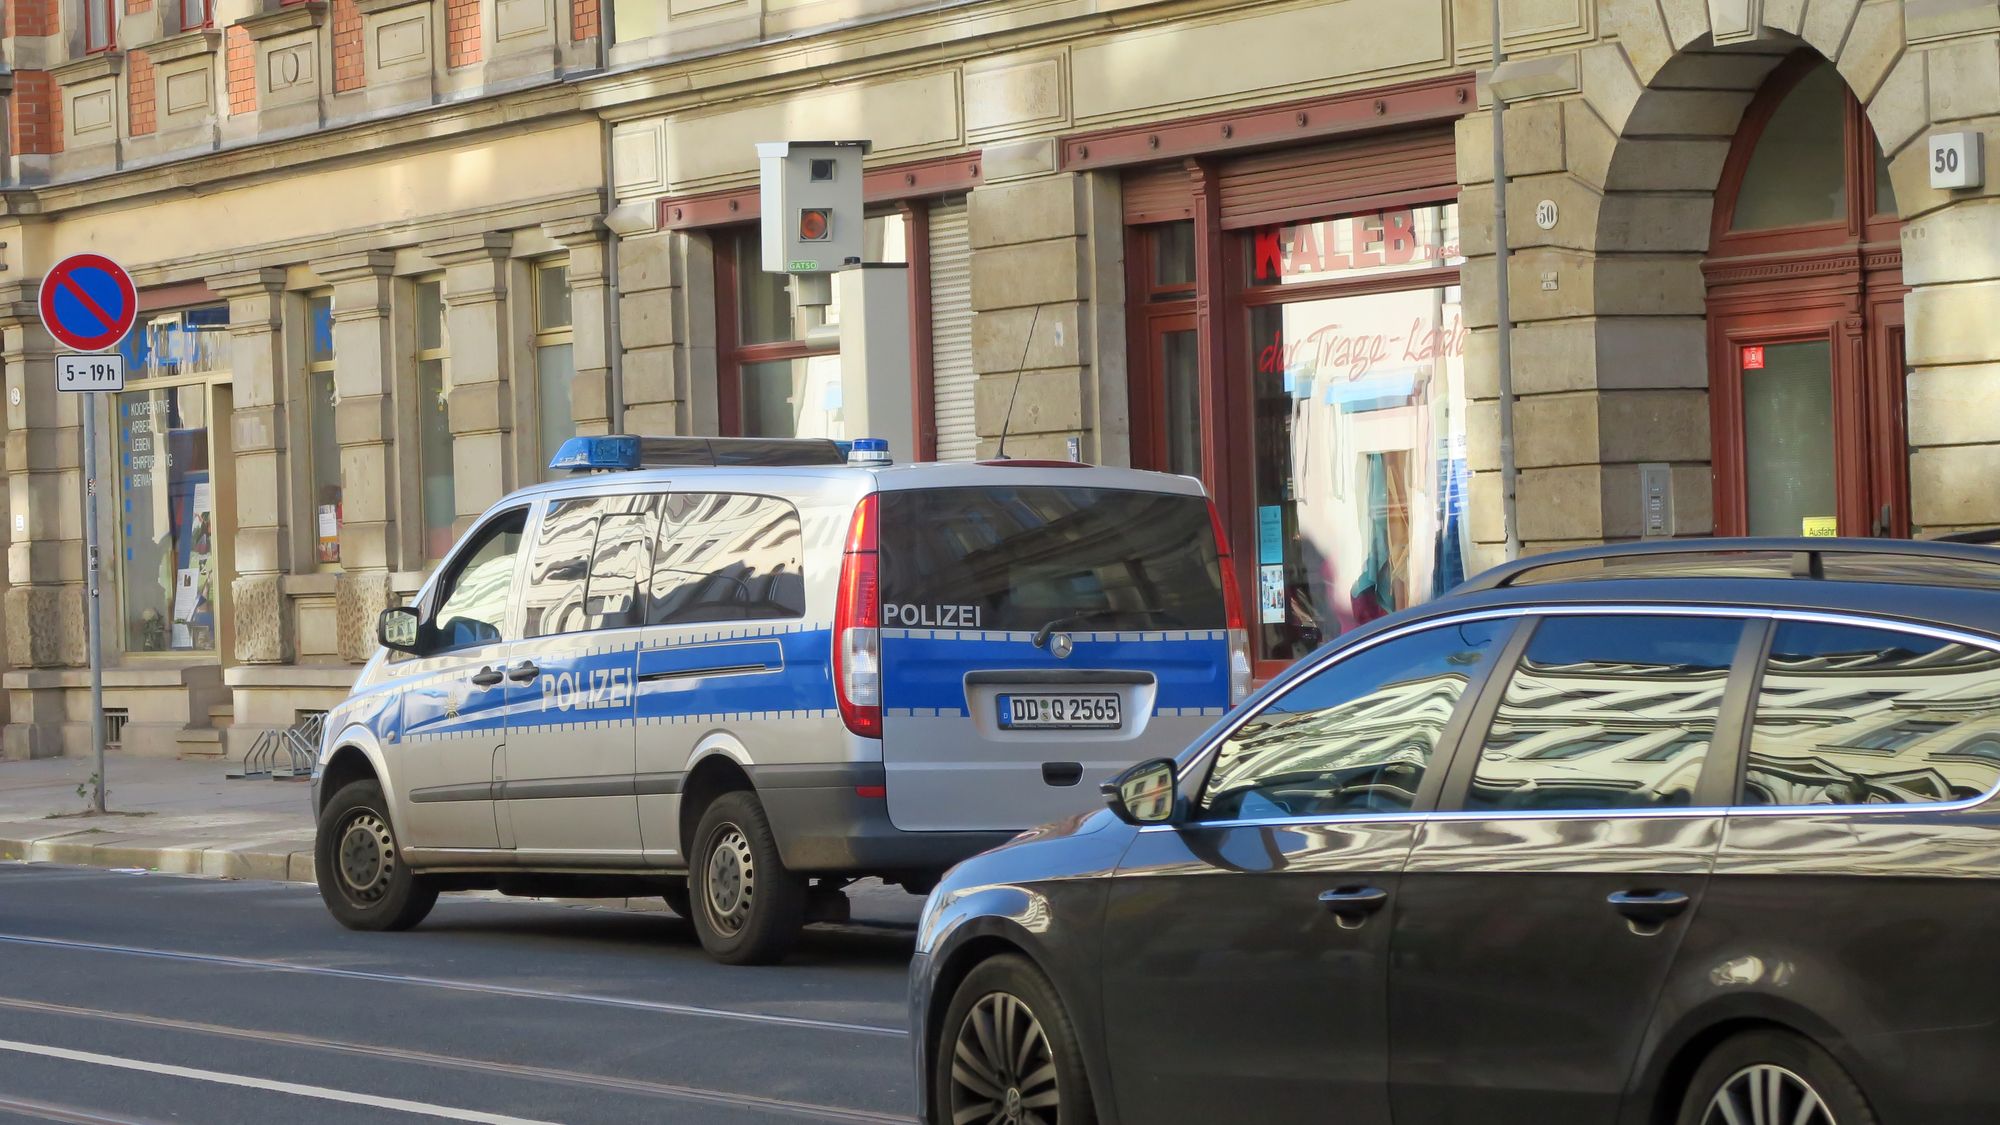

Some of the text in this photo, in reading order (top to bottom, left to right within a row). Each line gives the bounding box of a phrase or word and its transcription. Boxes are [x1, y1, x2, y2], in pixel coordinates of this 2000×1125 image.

[1934, 148, 1958, 173] 50
[1539, 204, 1554, 225] 50
[1255, 209, 1415, 279] KALEB
[789, 261, 817, 269] GATSO
[1257, 330, 1300, 373] der
[132, 437, 151, 452] LEBEN
[883, 603, 981, 627] POLIZEI
[541, 667, 633, 712] POLIZEI
[1012, 699, 1039, 720] DD
[1051, 699, 1065, 720] Q
[1069, 699, 1117, 720] 2565
